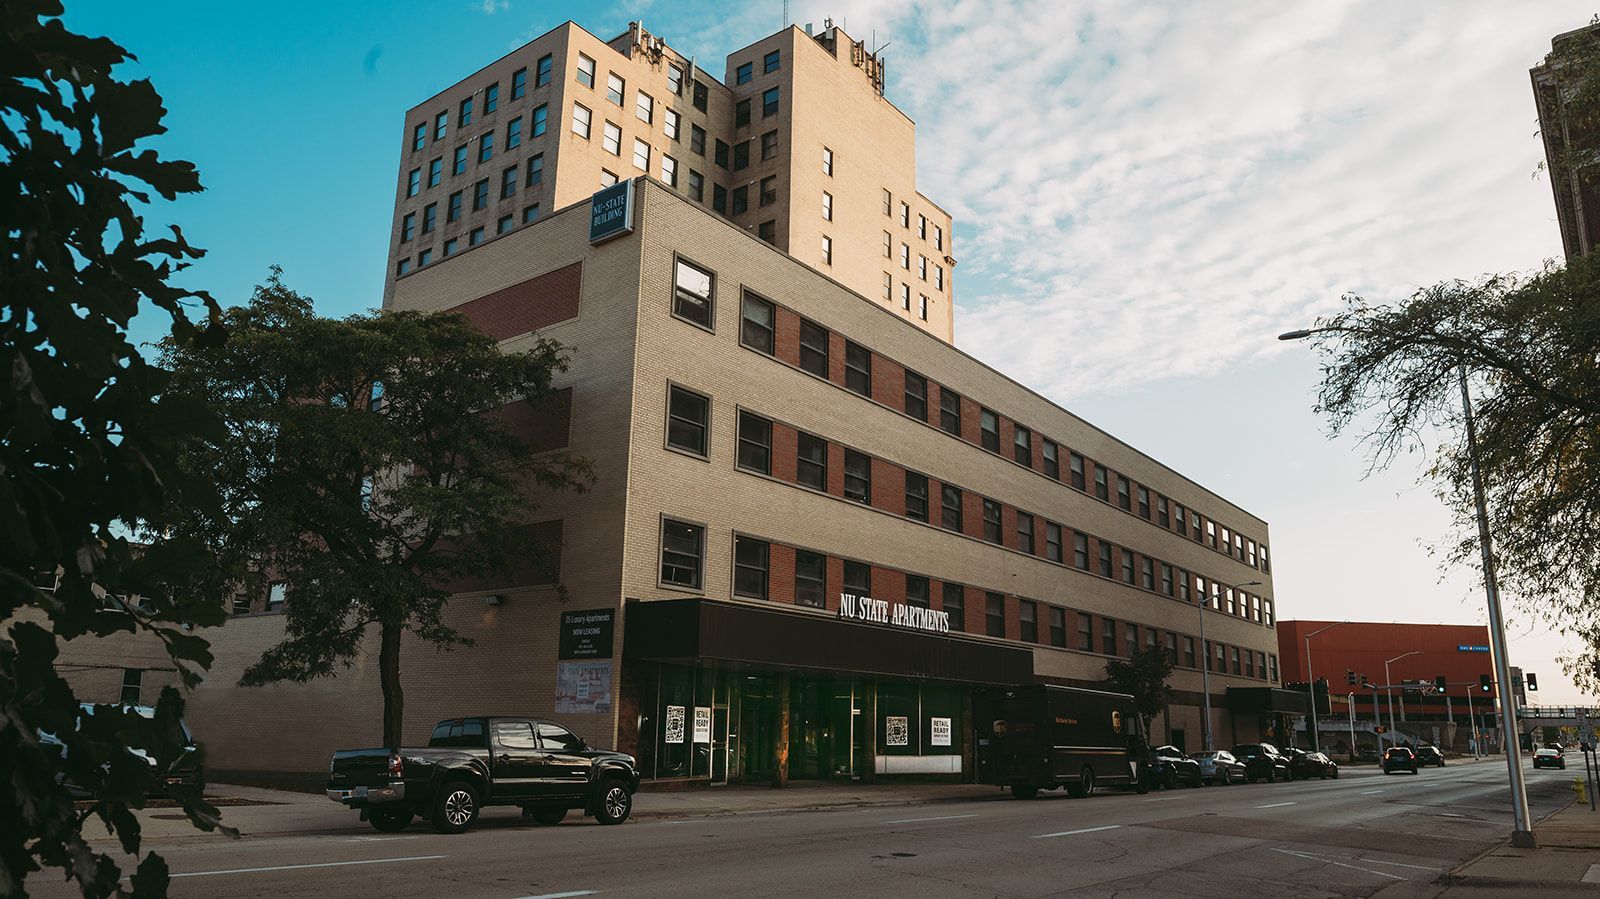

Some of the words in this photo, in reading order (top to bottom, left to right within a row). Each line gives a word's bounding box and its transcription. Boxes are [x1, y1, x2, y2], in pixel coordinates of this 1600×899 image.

[593, 195, 625, 215] NU-STATE
[594, 207, 623, 226] BUILDING
[586, 613, 610, 624] Apartments
[840, 593, 856, 618] NU
[859, 596, 889, 623] STATE
[892, 603, 949, 633] APARTMENTS
[933, 727, 949, 735] READY
